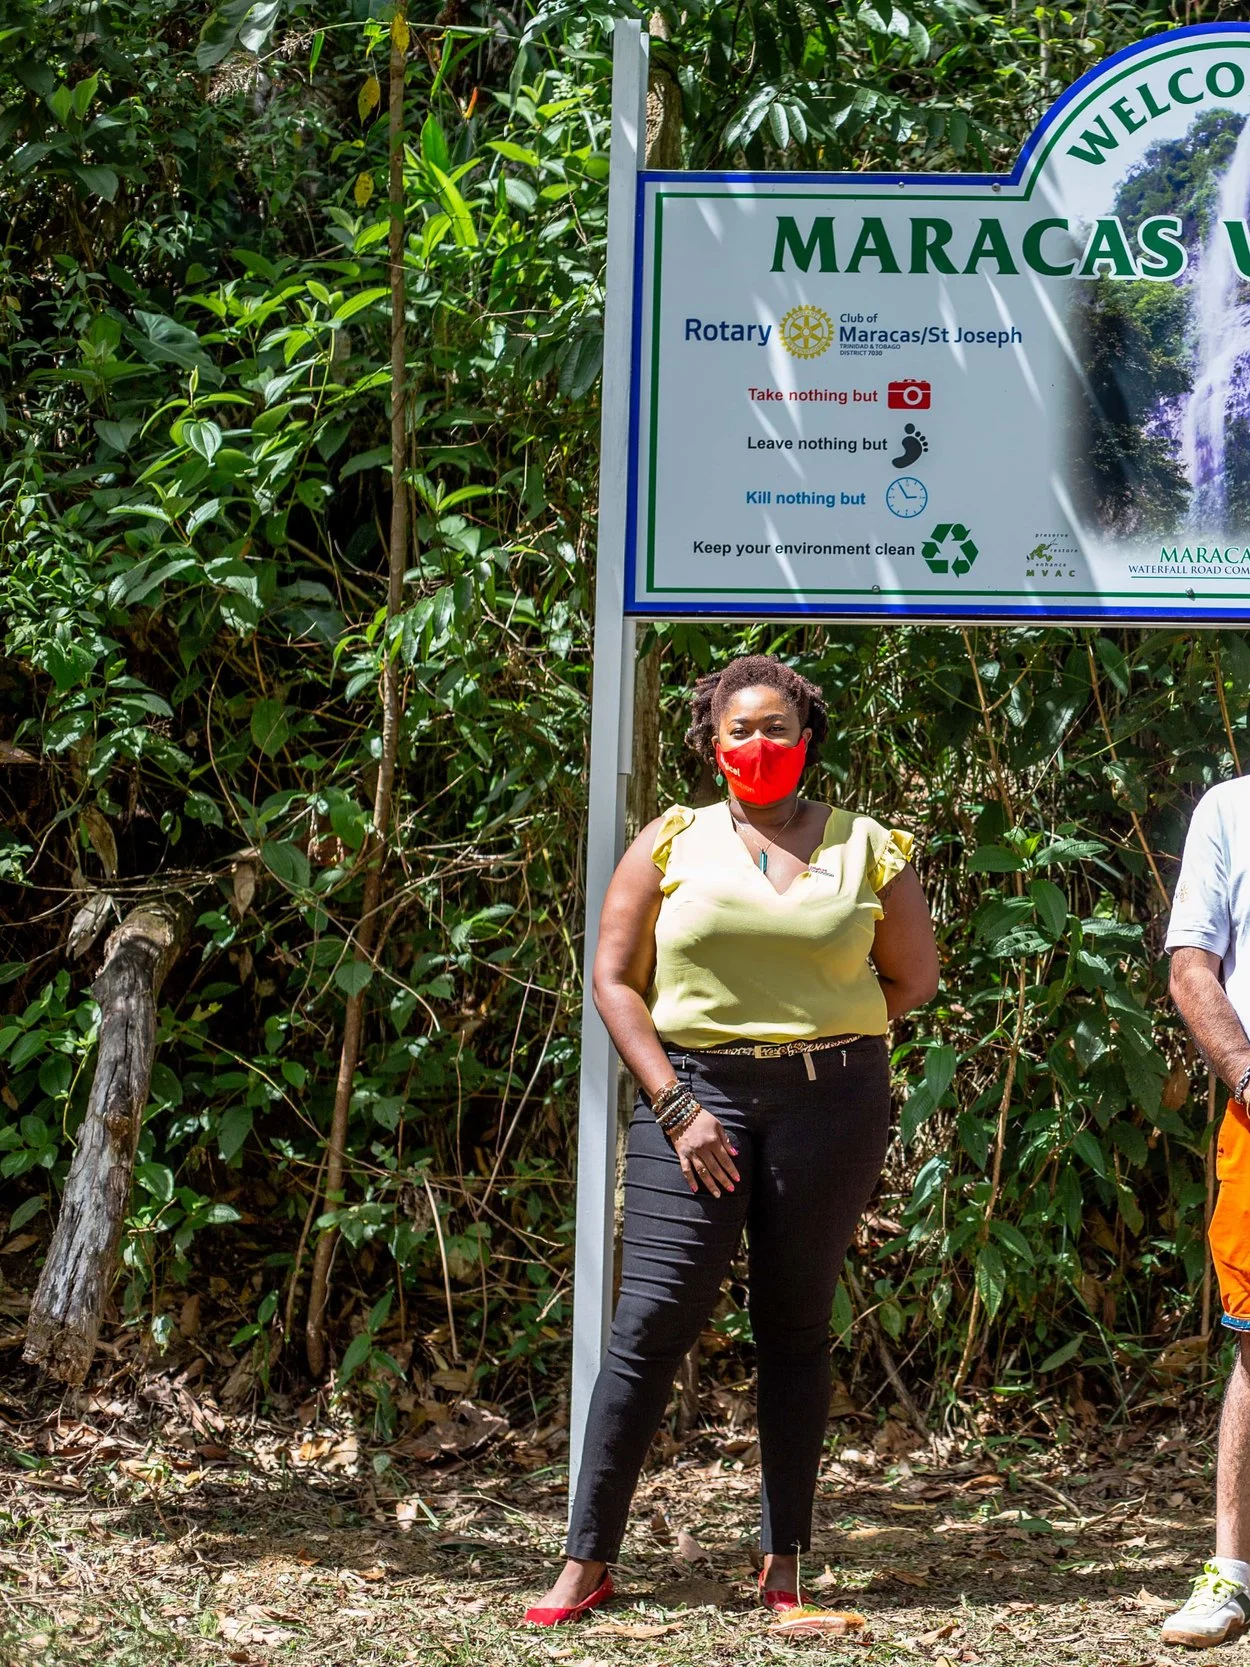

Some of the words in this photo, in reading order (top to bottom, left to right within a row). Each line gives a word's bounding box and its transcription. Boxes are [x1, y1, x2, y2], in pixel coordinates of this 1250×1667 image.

[769, 215, 1186, 278] MARACAS
[840, 313, 865, 323] Club
[866, 313, 878, 323] of
[685, 317, 773, 347] Rotary
[839, 326, 949, 346] Maracas/St
[953, 327, 1022, 349] Joseph
[748, 388, 784, 402] Take
[789, 389, 848, 405] nothing
[853, 390, 878, 403] but
[748, 437, 793, 450] Leave
[798, 437, 857, 454] nothing
[862, 438, 888, 451] but
[746, 491, 771, 504] Kill
[776, 491, 835, 508] nothing
[841, 491, 866, 505] but
[693, 541, 732, 557] Keep
[736, 544, 771, 558] your
[775, 542, 871, 556] environment
[875, 543, 915, 556] clean
[1128, 565, 1189, 575] WATERFALL
[1190, 565, 1223, 575] ROAD
